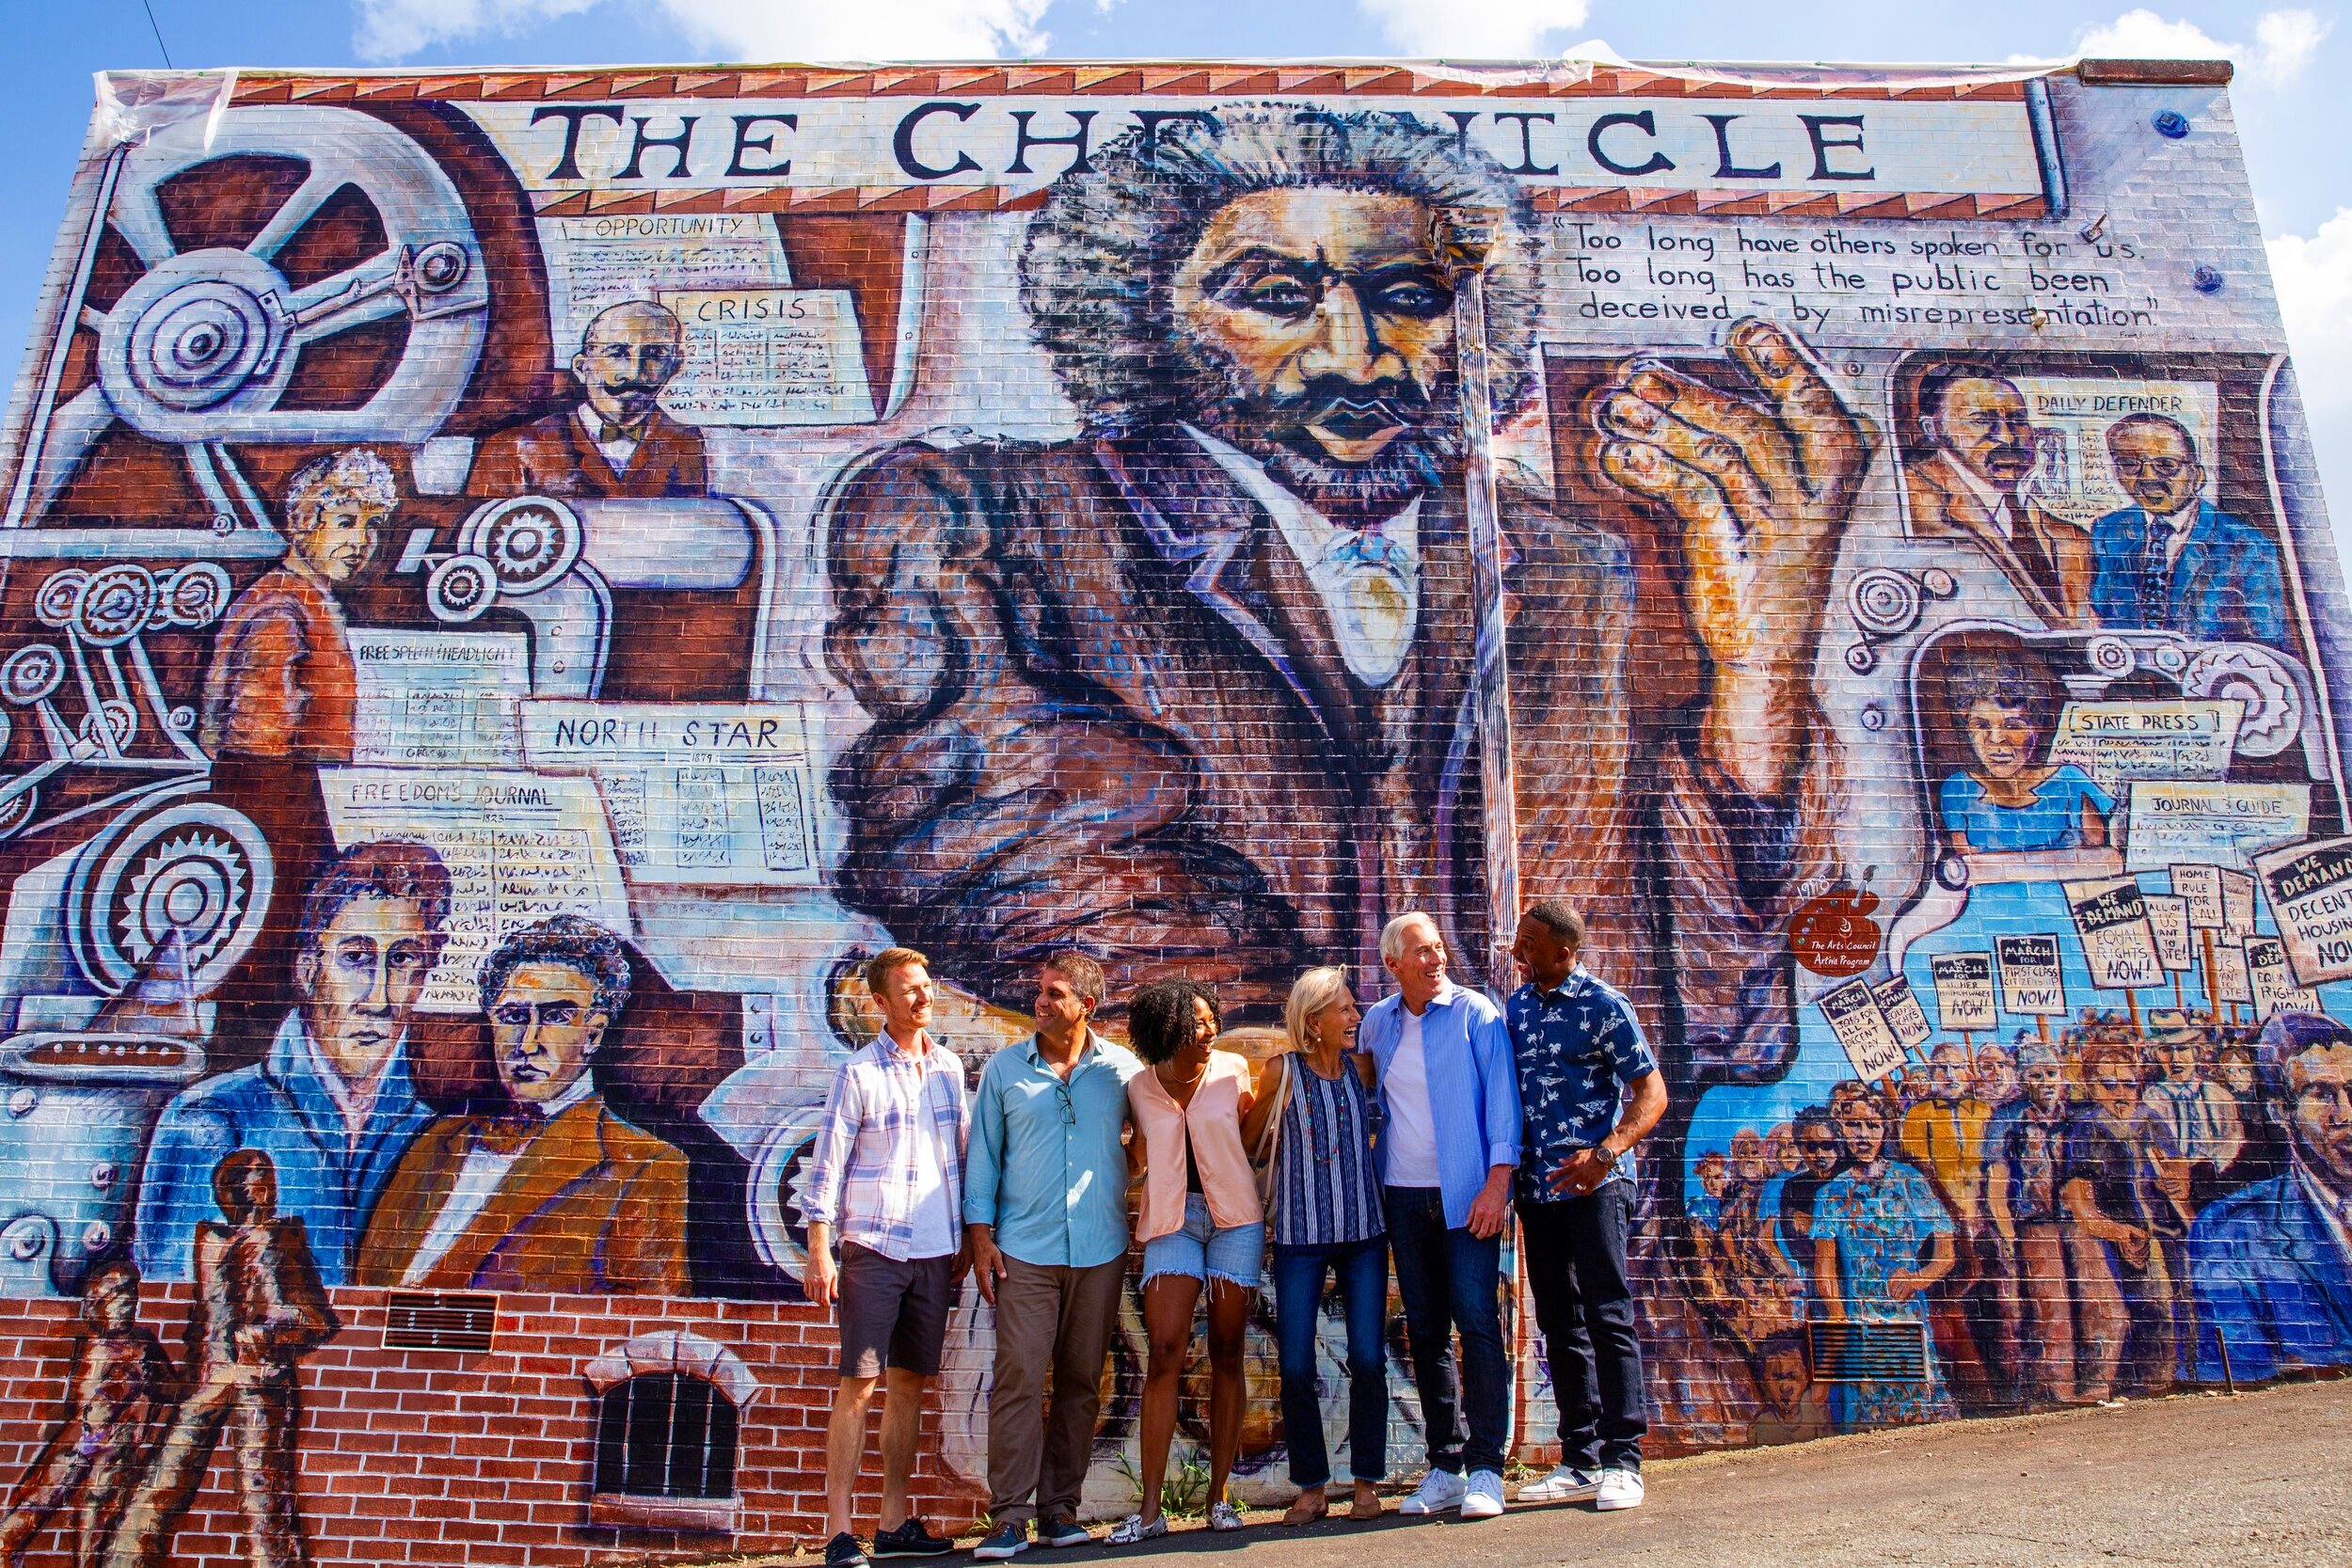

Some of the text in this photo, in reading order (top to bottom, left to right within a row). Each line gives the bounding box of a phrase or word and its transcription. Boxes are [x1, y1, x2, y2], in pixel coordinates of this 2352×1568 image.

[530, 104, 798, 180] THE
[595, 217, 743, 237] OPPORTUNITY
[1648, 226, 1714, 261] long
[1737, 227, 1801, 254] have
[1810, 229, 1897, 255] others
[1911, 231, 2000, 263] spoken
[2022, 231, 2068, 257] for
[2097, 242, 2146, 261] us.
[1565, 256, 2109, 298] Too long has the public been
[697, 297, 806, 322] CRISIS
[1579, 291, 1733, 321] deceived
[1791, 294, 1830, 334] by
[2037, 395, 2183, 412] DAILY DEFENDER
[359, 645, 390, 660] FREE
[2081, 715, 2200, 731] STATE PRESS
[555, 719, 778, 748] NORTH STAR
[691, 753, 712, 763] 1879
[469, 785, 554, 805] JOURNAL
[2153, 798, 2217, 814] JOURNAL
[2235, 799, 2283, 815] GUIDE
[482, 814, 506, 824] 1823
[2295, 854, 2323, 875] WE
[2180, 870, 2210, 879] HOME
[2182, 882, 2208, 894] RULE
[2097, 892, 2119, 908] WE
[2188, 895, 2210, 907] FOR
[2086, 899, 2143, 926] DEMAND
[2095, 928, 2141, 945] EQUAL
[2296, 916, 2352, 942] HOUSIN
[1811, 940, 1876, 950] The Arts Council
[2164, 939, 2176, 947] TO
[2005, 945, 2051, 958] MARCH
[2097, 947, 2148, 960] RIGHTS
[1839, 955, 1870, 969] Program
[1938, 965, 1983, 974] MARCH
[2106, 959, 2151, 980] NOW!
[2005, 966, 2058, 977] FIRST CLASS
[2258, 973, 2285, 983] EQUA
[1831, 990, 1866, 1011] MARCH
[1837, 990, 1850, 999] WE
[2017, 990, 2058, 1006] NOW!
[1951, 998, 1989, 1018] NOW!
[1841, 1024, 1862, 1038] ALL
[1845, 1025, 1880, 1049] DECENT
[1862, 1039, 1899, 1075] NOW!
